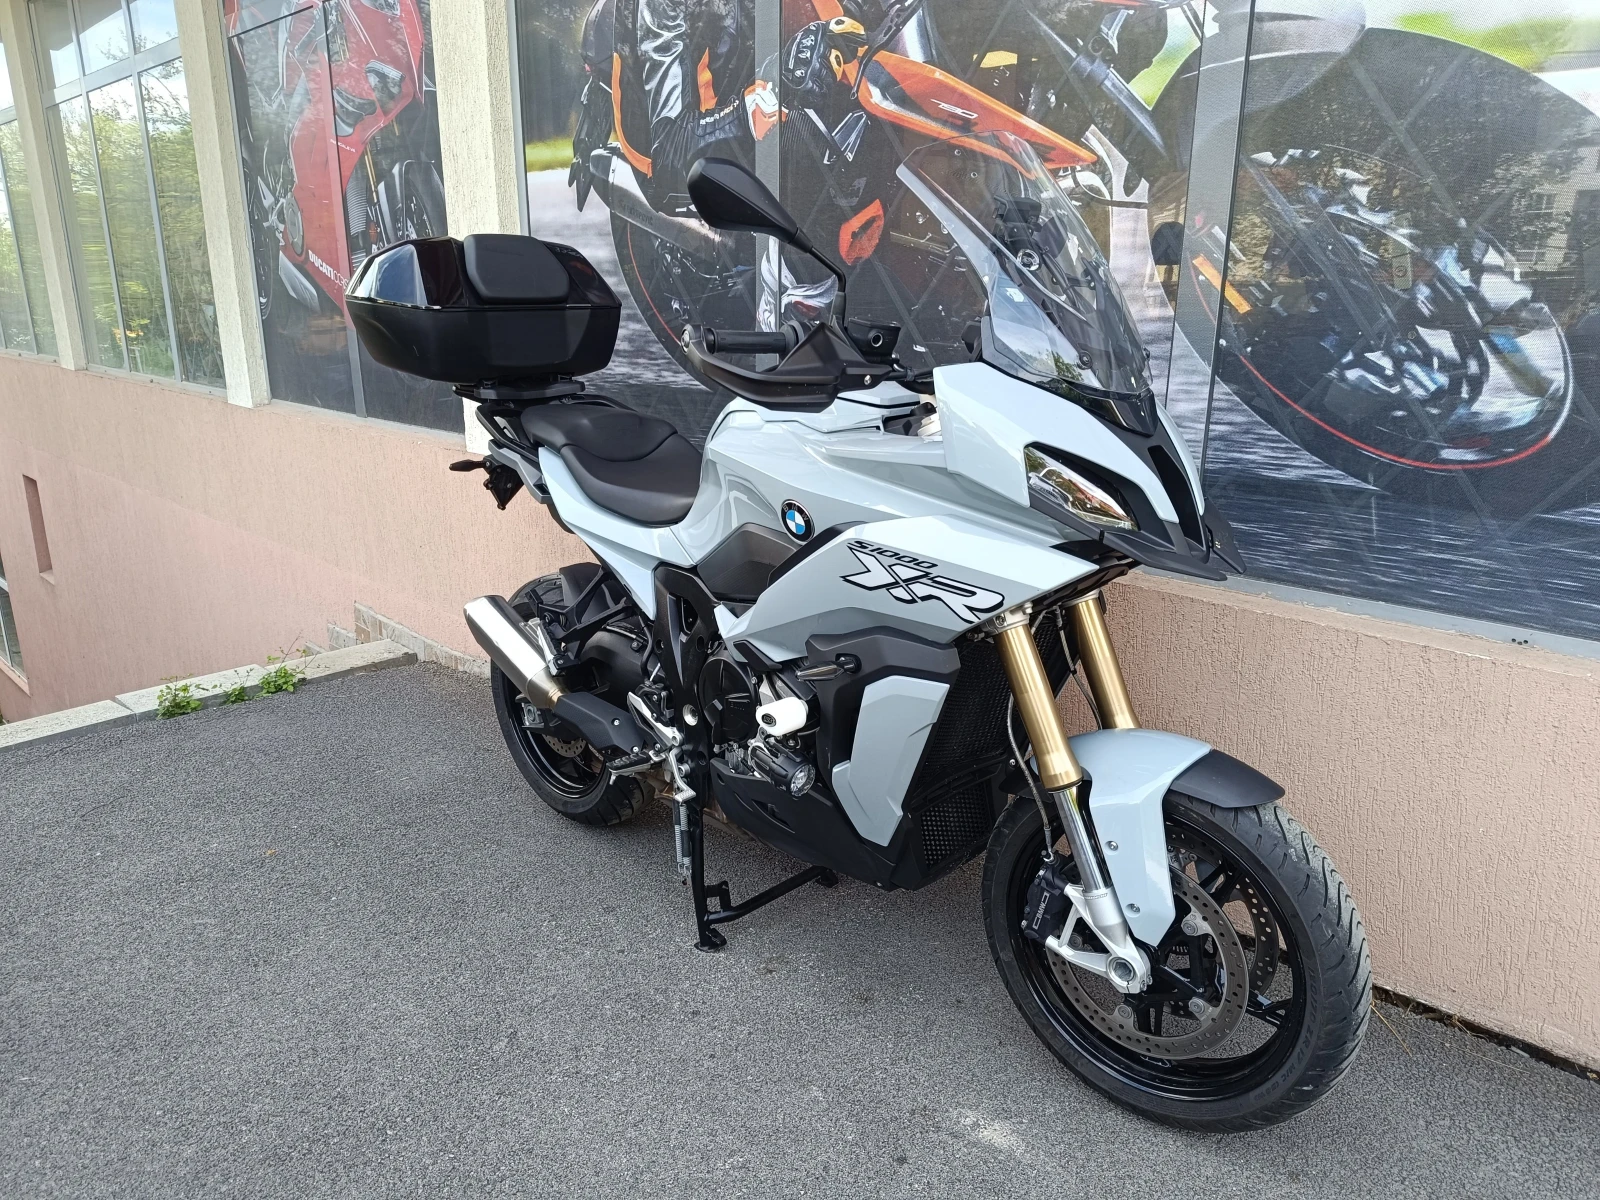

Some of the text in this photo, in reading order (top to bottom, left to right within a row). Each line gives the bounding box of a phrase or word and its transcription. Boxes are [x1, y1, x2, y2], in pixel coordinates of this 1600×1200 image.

[308, 249, 334, 281] DUCATI
[782, 503, 809, 522] BMW
[847, 540, 938, 570] S1000
[839, 545, 1005, 624] XR
